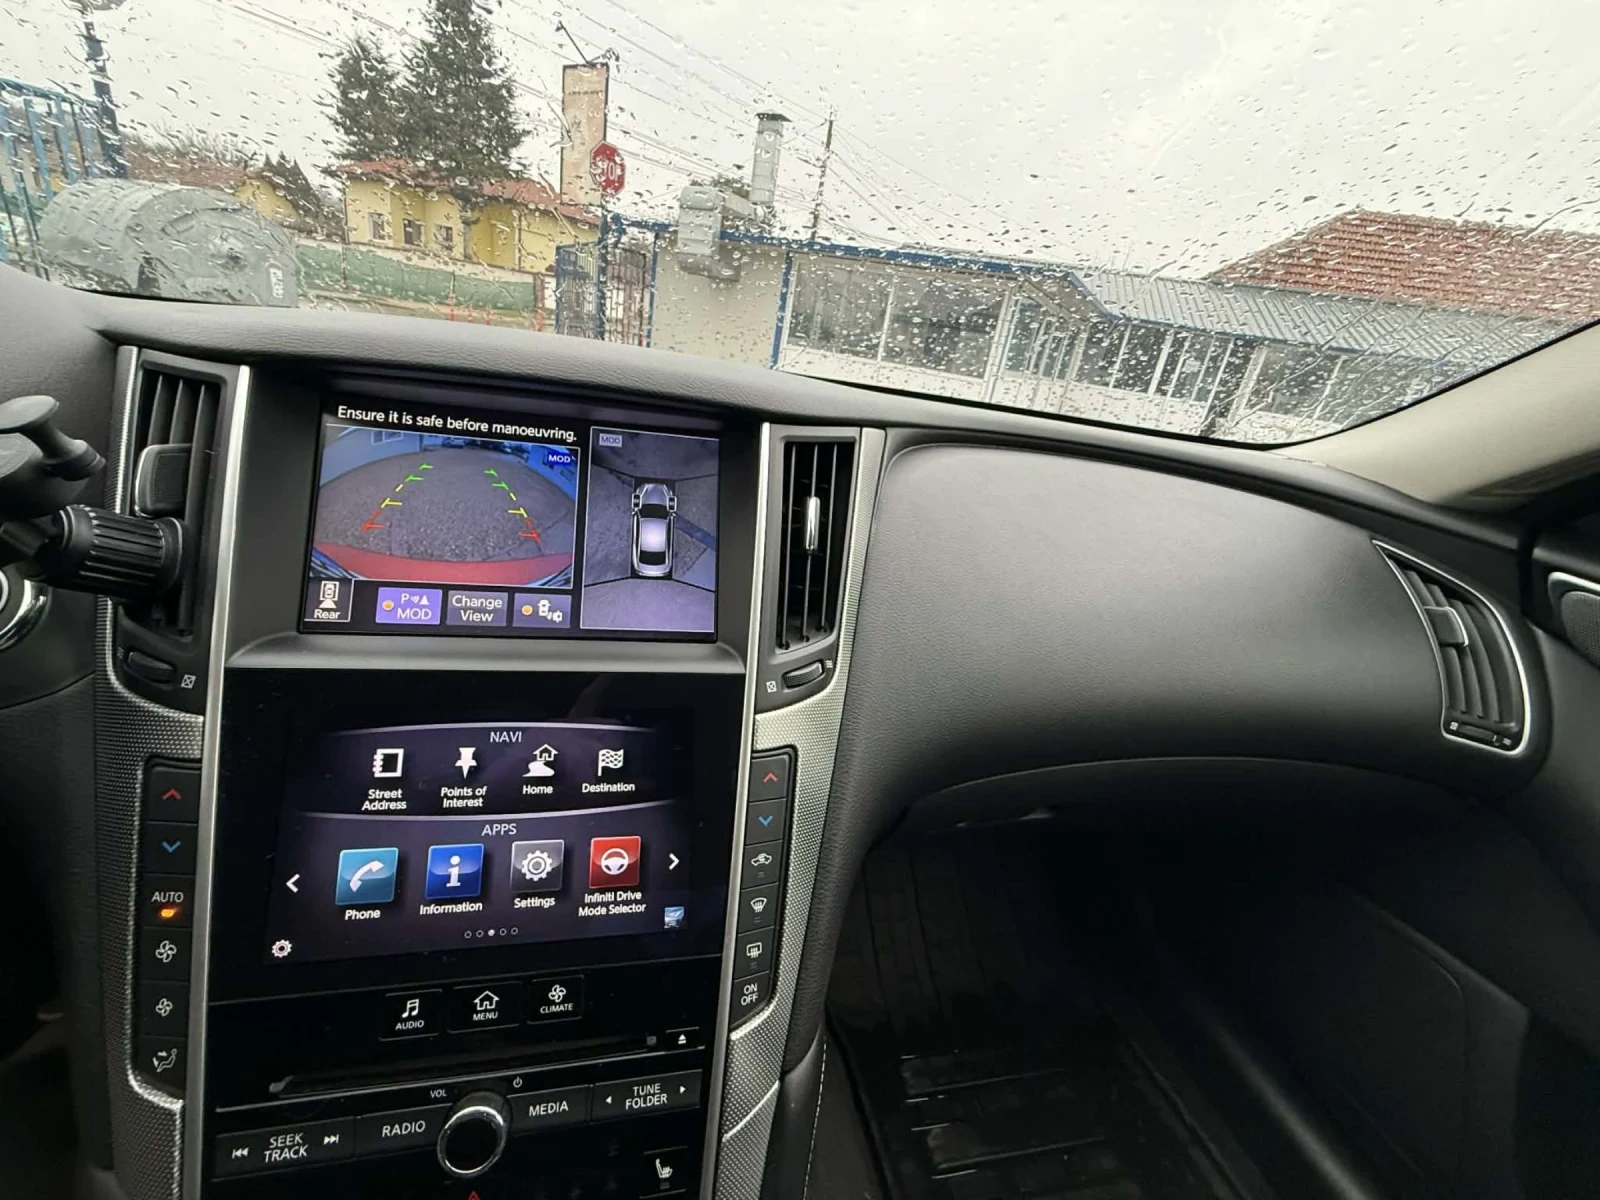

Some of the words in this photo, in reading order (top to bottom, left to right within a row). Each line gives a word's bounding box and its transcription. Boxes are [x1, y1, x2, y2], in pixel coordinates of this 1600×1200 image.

[337, 405, 385, 422] Ensure
[388, 410, 399, 424] it
[402, 412, 413, 425] is
[416, 414, 443, 428] safe
[446, 416, 489, 432] before
[492, 422, 577, 443] manoeuvring.
[600, 434, 621, 445] MOD
[548, 454, 571, 464] MOD
[452, 595, 502, 608] Change
[314, 608, 340, 620] Rear
[397, 607, 432, 620] MOD
[460, 609, 493, 622] View
[489, 731, 522, 744] NAVI
[440, 786, 473, 798] Points
[475, 785, 487, 797] of
[522, 784, 553, 795] Home
[581, 781, 635, 793] Destination
[368, 788, 402, 800] Street
[361, 798, 407, 811] Address
[442, 796, 482, 808] Interest
[481, 823, 517, 836] APPS
[151, 891, 184, 903] AUTO
[584, 891, 614, 903] Infiniti
[616, 889, 642, 902] Drive
[419, 902, 483, 915] Information
[513, 896, 556, 910] Settings
[578, 905, 607, 917] Mode
[608, 902, 646, 915] Selector
[344, 908, 381, 920] Phone
[743, 982, 757, 995] ON
[741, 993, 758, 1006] OFF
[540, 1003, 574, 1014] CLIMATE
[472, 1011, 499, 1022] MENU
[395, 1020, 425, 1031] AUDIO
[430, 1088, 447, 1098] VOL
[632, 1083, 662, 1097] TUNE
[625, 1093, 668, 1110] FOLDER
[528, 1100, 569, 1117] MEDIA
[381, 1120, 426, 1138] RADIO
[269, 1132, 303, 1149] SEEK
[263, 1145, 308, 1163] TRACK
